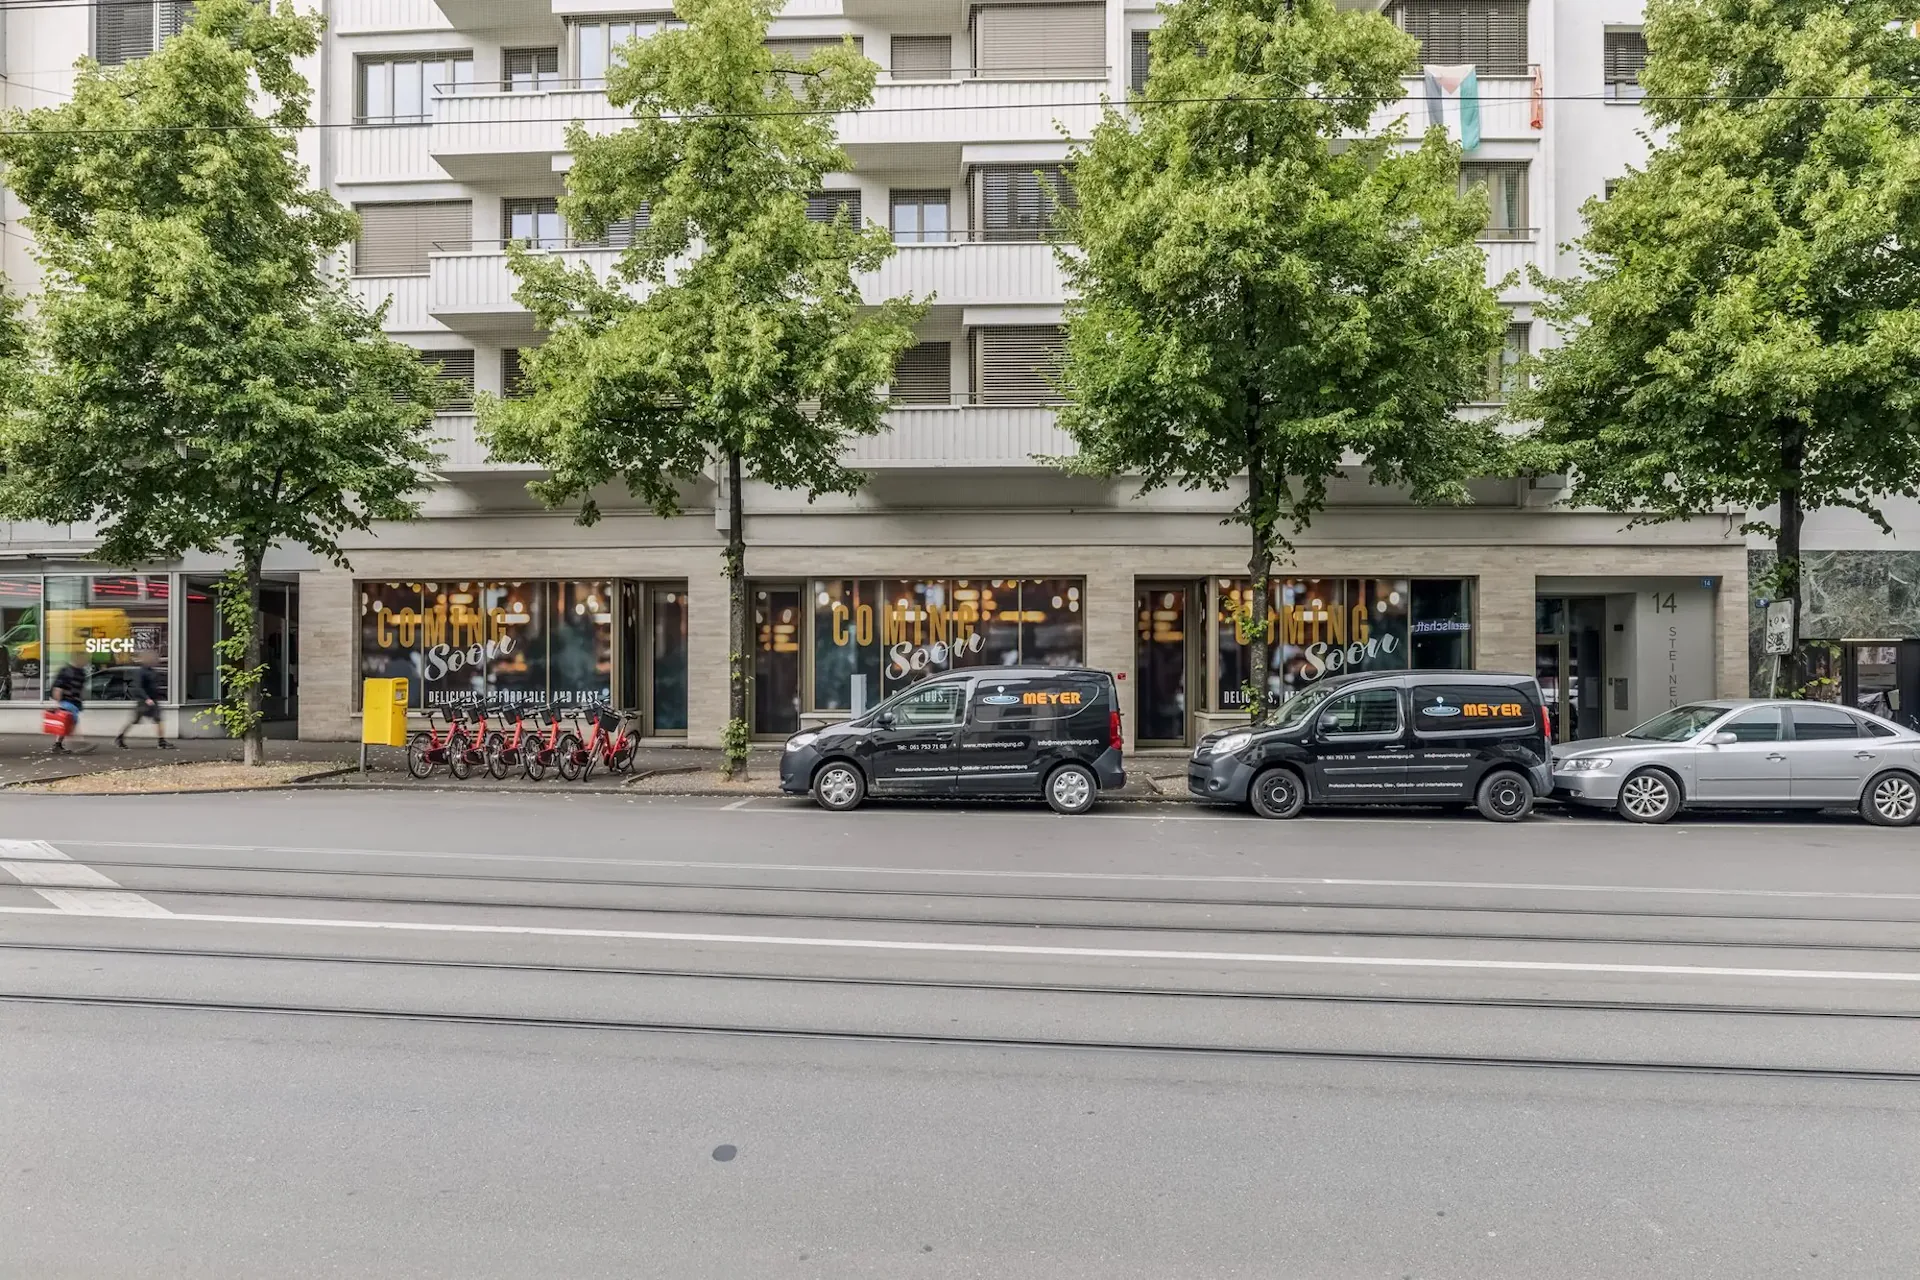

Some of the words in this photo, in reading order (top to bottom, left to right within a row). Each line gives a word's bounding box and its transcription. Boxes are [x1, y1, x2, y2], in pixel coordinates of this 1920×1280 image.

[1703, 579, 1711, 587] 14
[1652, 592, 1678, 614] 14
[378, 607, 507, 648] COMING
[833, 604, 975, 646] COMING
[85, 637, 135, 653] SIECH
[424, 634, 517, 682] Soon
[885, 633, 986, 680] Soon
[1300, 633, 1399, 681] Soon
[554, 690, 571, 703] AND
[577, 690, 599, 703] FAST
[1022, 692, 1082, 705] MEYER
[1463, 703, 1522, 717] MEYER
